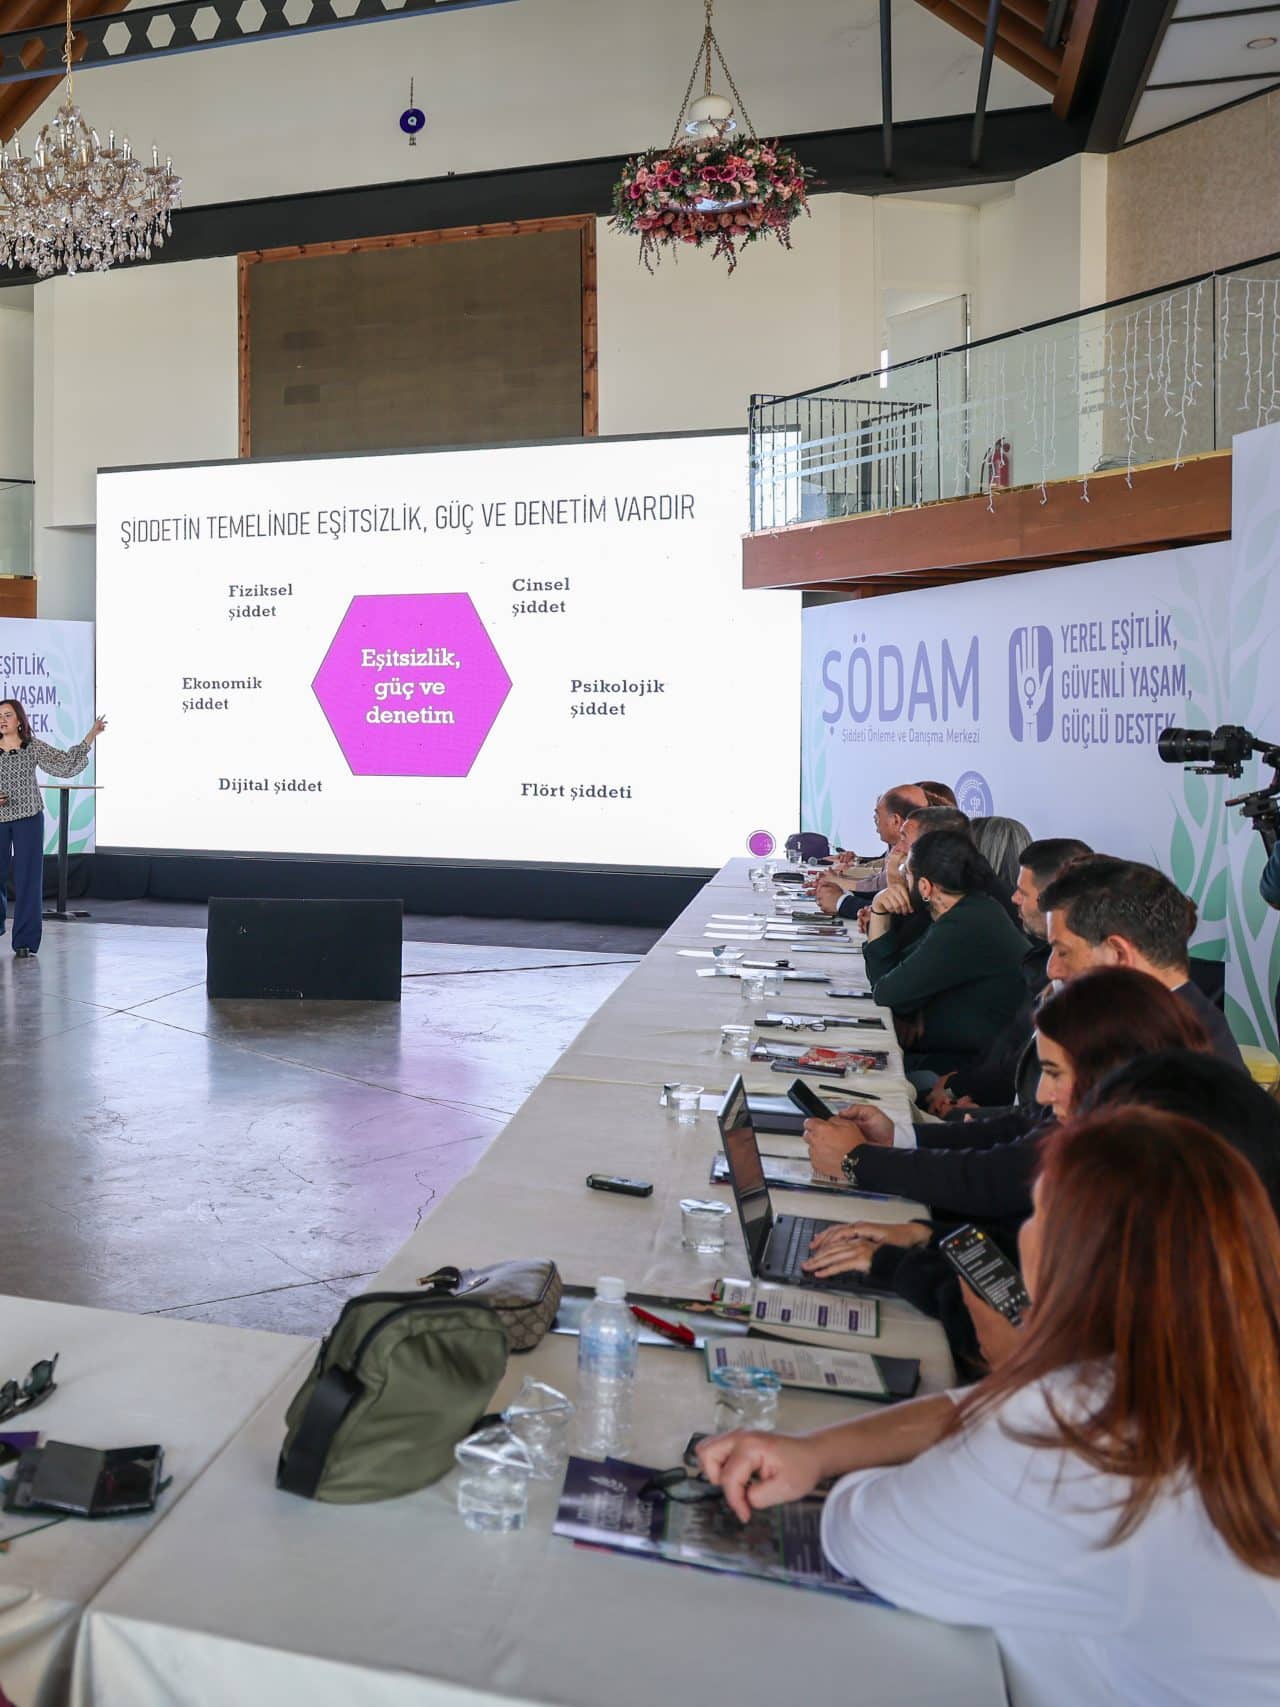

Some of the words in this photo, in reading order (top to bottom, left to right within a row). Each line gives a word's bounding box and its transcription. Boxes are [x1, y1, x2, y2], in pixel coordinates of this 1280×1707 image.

[120, 514, 200, 549] ŞİDDETİN
[207, 509, 311, 539] TEMELİNDE
[318, 502, 427, 540] EŞİTSİZLİK,
[435, 500, 474, 535] GÜÇ
[481, 502, 507, 527] VE
[514, 494, 607, 526] DENETİM
[614, 493, 696, 522] VARDIR
[228, 583, 293, 598] Fiziksel
[512, 577, 570, 592] Cinsel
[228, 605, 277, 621] şiddet
[512, 600, 566, 617] şiddet
[1061, 621, 1107, 653] YEREL
[1111, 609, 1178, 656] EŞİTLİK,
[360, 647, 461, 672] Eşitsizlik,
[182, 677, 263, 690] Ekonomik
[374, 677, 415, 700] güç
[419, 681, 446, 695] ve
[570, 679, 665, 697] Psikolojik
[1061, 661, 1125, 700] GÜVENLİ
[1130, 663, 1193, 703] YAŞAM,
[11, 685, 61, 708] YAŞAM,
[182, 697, 229, 714] şiddet
[365, 705, 456, 724] denetim
[570, 701, 626, 719] şiddet
[1061, 708, 1110, 749] GÜÇLÜ
[218, 777, 269, 794] Dijital
[273, 778, 323, 795] şiddet
[520, 782, 565, 797] Flört
[570, 784, 632, 801] şiddeti
